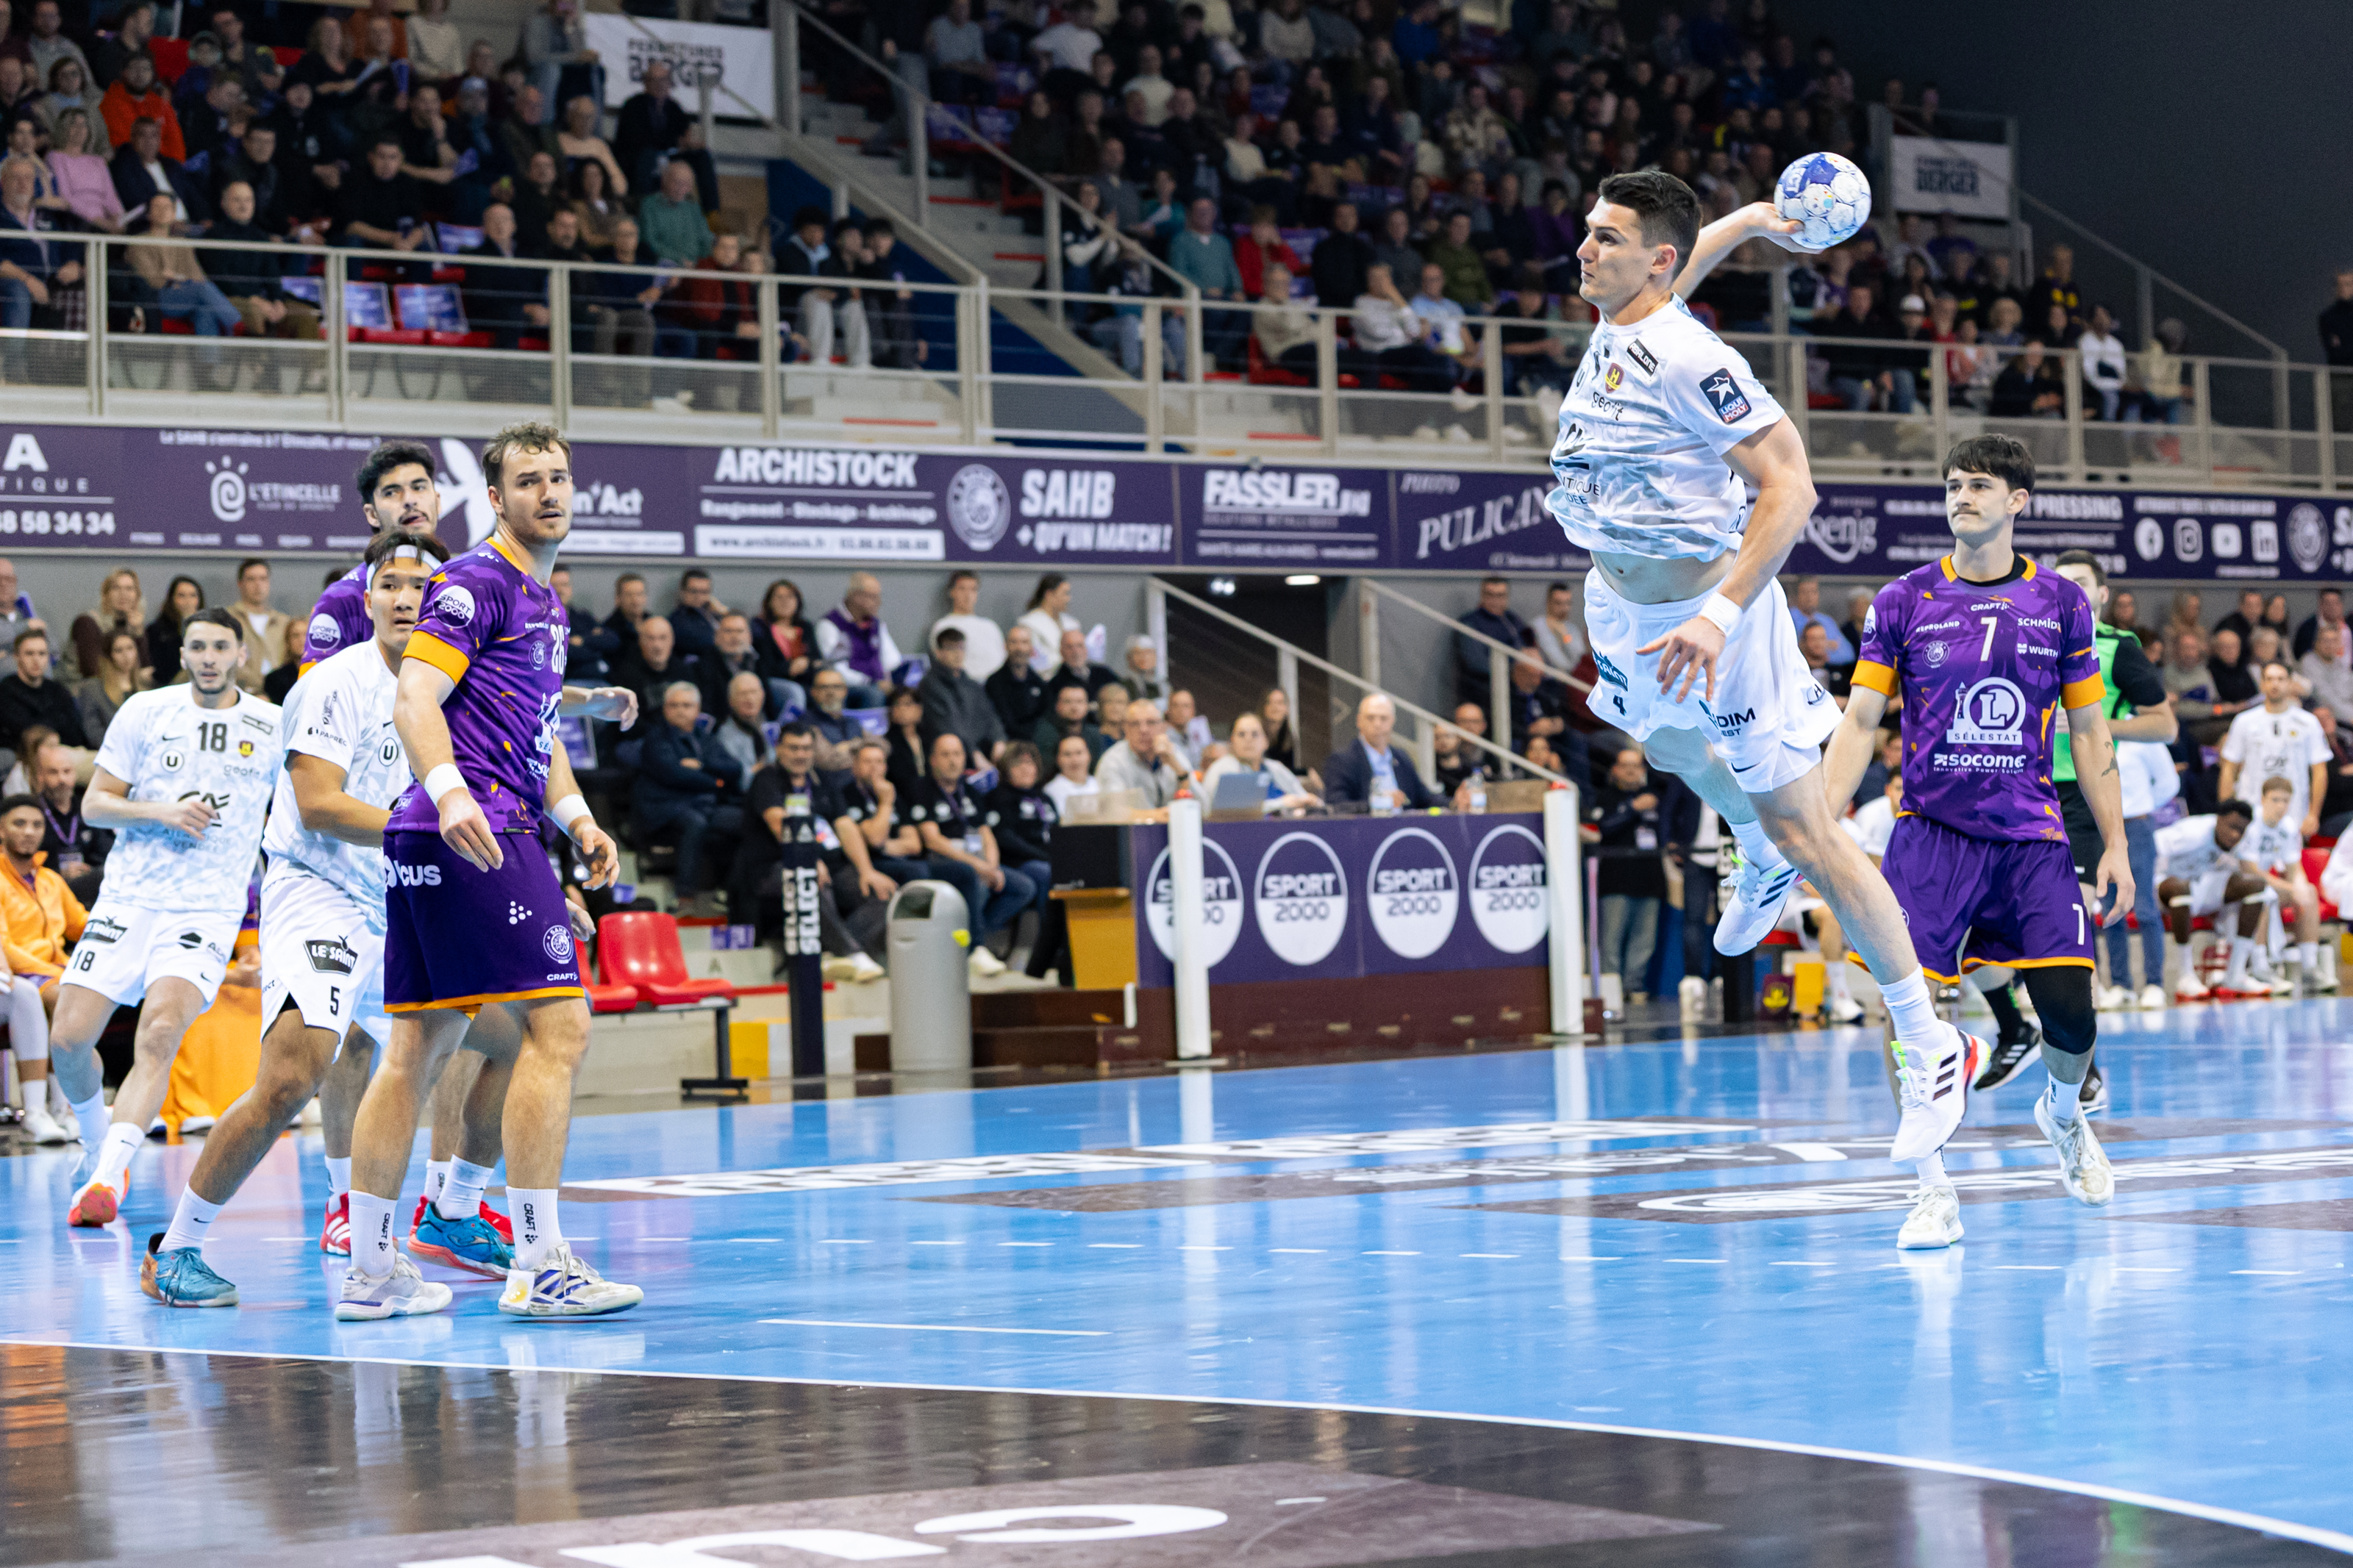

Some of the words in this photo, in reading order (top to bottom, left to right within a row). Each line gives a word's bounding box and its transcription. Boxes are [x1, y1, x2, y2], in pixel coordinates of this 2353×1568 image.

[1720, 398, 1743, 415] LIQUI
[1724, 405, 1748, 422] MOLY
[714, 448, 919, 488] ARCHISTOCK
[1021, 469, 1116, 519] SAHB
[1204, 470, 1340, 507] FASSLER
[54, 510, 83, 536] 34
[85, 511, 117, 536] 34
[438, 601, 465, 620] 2000
[439, 594, 472, 615] SPORT
[1971, 603, 2002, 612] CRAFT
[550, 624, 565, 675] 26
[1980, 617, 1997, 662] 7
[1613, 694, 1627, 717] 4
[1713, 708, 1756, 728] DIM
[198, 722, 228, 753] 18
[320, 731, 347, 747] PAPREC
[1954, 728, 2018, 742] SÉLESTAT
[166, 756, 178, 767] U
[383, 745, 393, 761] U
[1264, 873, 1337, 898] SPORT
[1377, 867, 1446, 894] SPORT
[1477, 863, 1545, 888] SPORT
[796, 867, 821, 956] SELECT
[1274, 902, 1330, 922] 2000
[1387, 895, 1442, 917] 2000
[1487, 890, 1540, 912] 2000
[312, 945, 326, 958] LE
[329, 947, 356, 969] SAINT
[547, 973, 574, 981] CRAFT
[329, 986, 340, 1016] 5
[381, 1213, 390, 1239] CRAFT
[524, 1203, 536, 1231] CRAFT
